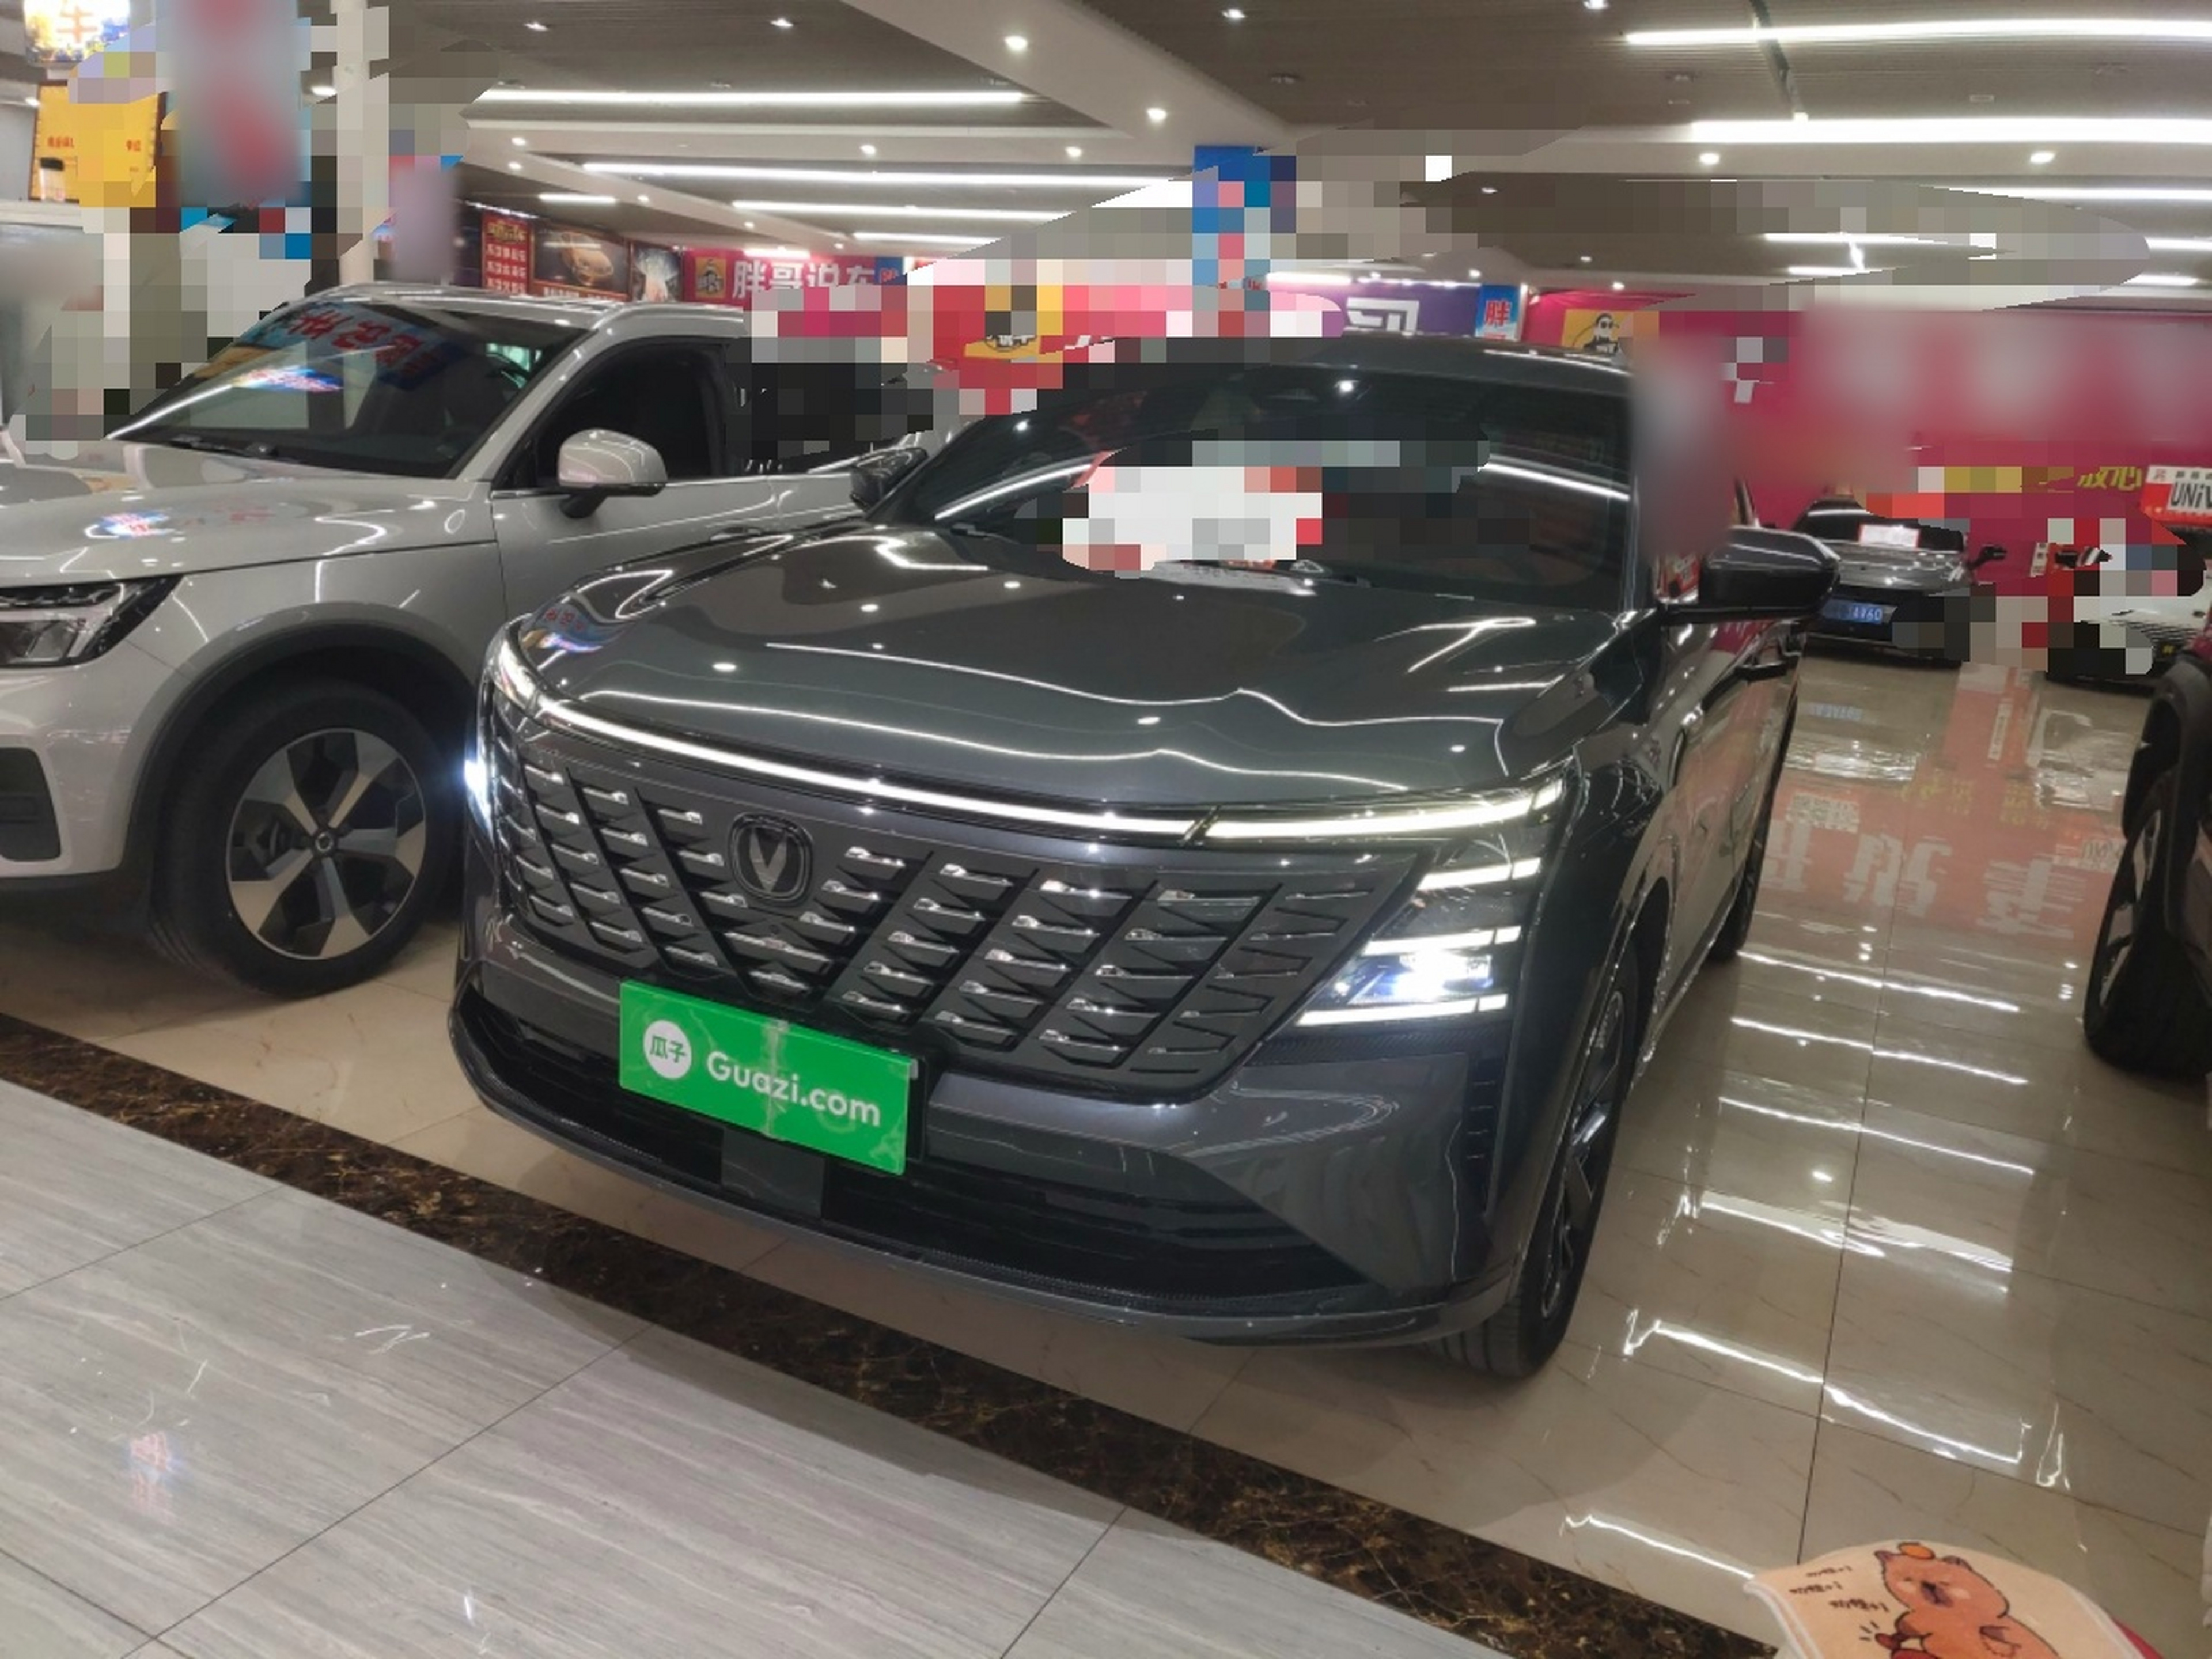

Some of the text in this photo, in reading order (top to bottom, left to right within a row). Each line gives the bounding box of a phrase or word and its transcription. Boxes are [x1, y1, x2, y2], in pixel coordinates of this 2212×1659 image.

[1484, 299, 1511, 339] 胖
[649, 1036, 687, 1064] 瓜子
[707, 1051, 881, 1126] Guazi.com
